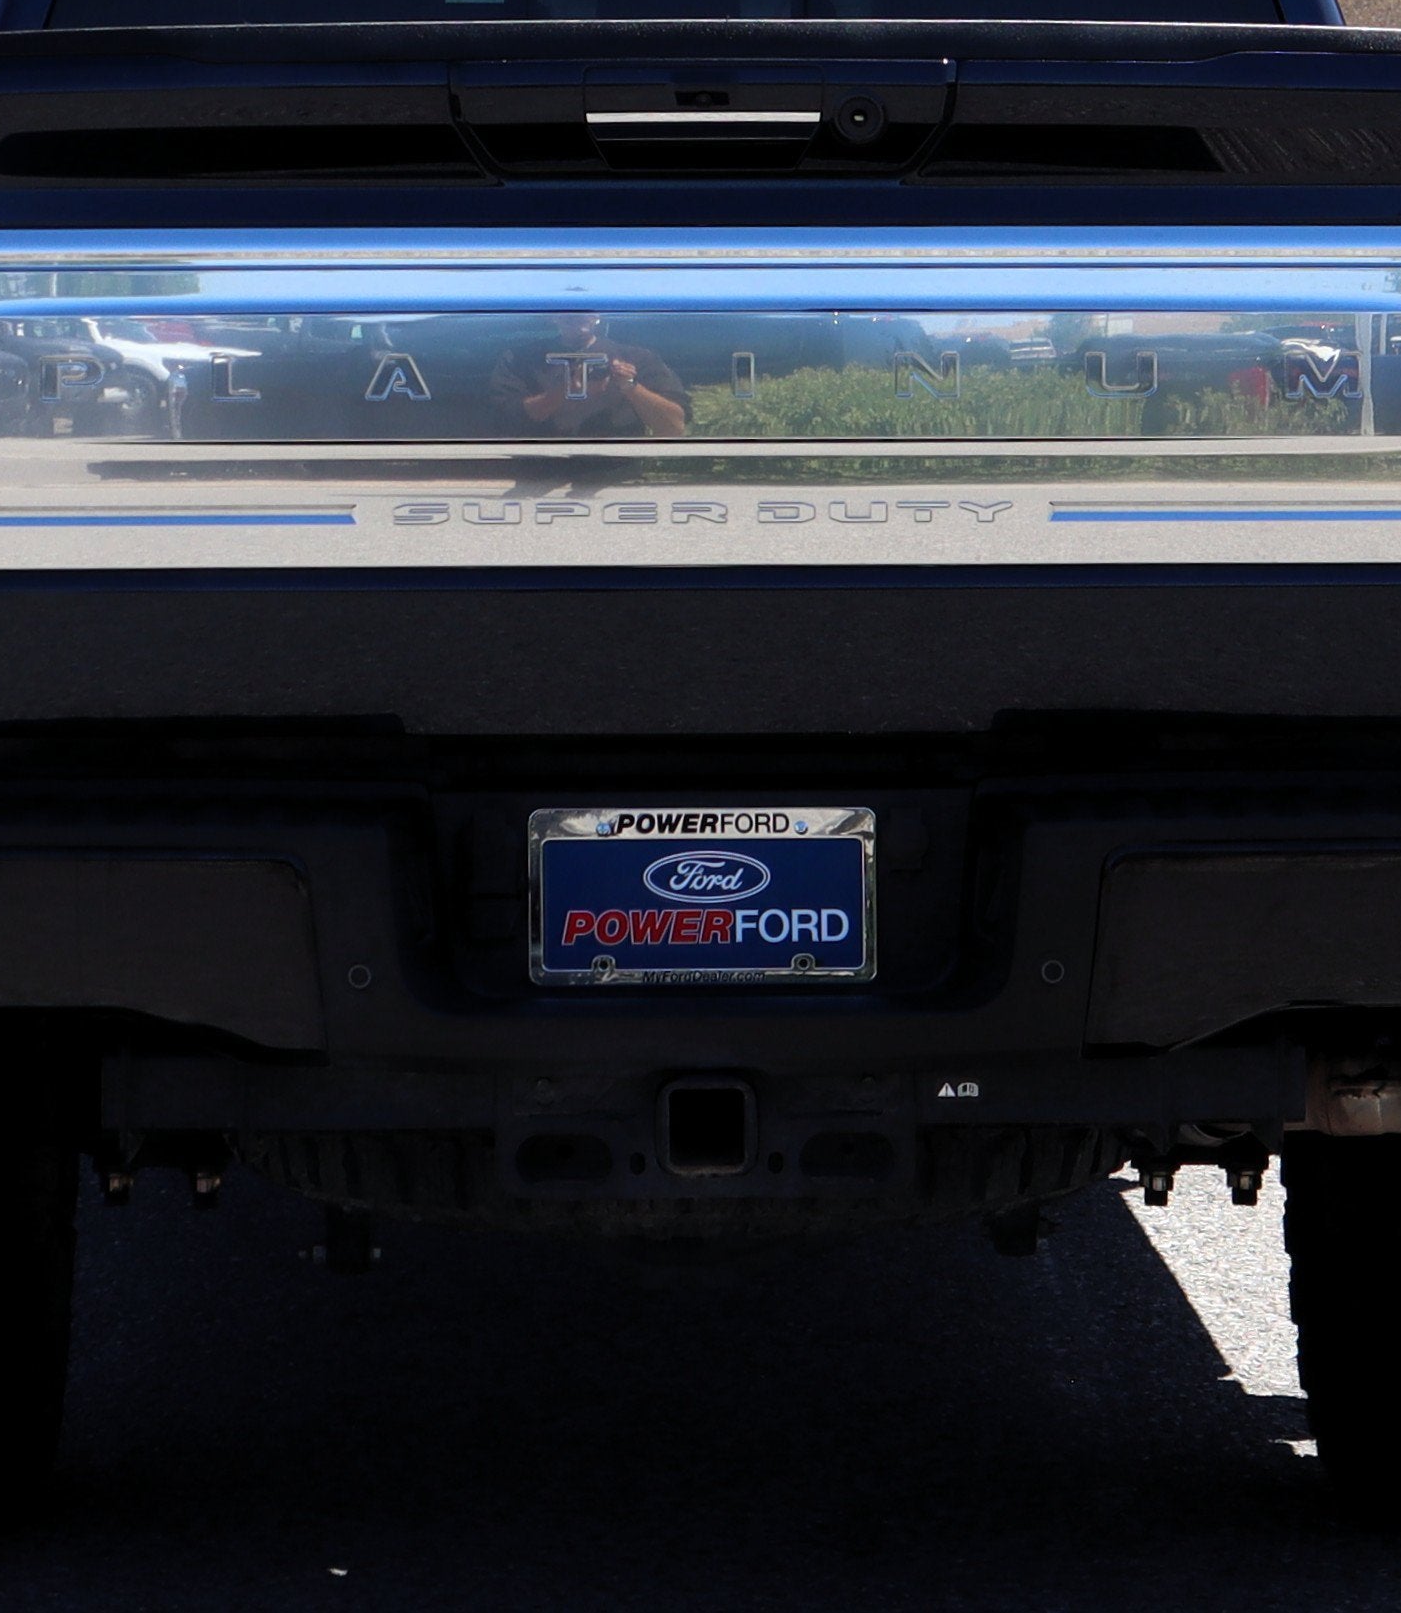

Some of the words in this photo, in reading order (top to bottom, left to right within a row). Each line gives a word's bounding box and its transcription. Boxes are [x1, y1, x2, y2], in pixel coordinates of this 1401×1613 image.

[40, 351, 1363, 402] PLATINUM
[393, 502, 728, 524] SUPER
[757, 501, 1013, 523] DUTY
[616, 812, 790, 834] POWERFORD
[669, 860, 744, 892] Ford
[561, 908, 850, 945] POWERFORD
[641, 970, 767, 985] MyFordDealer.com
